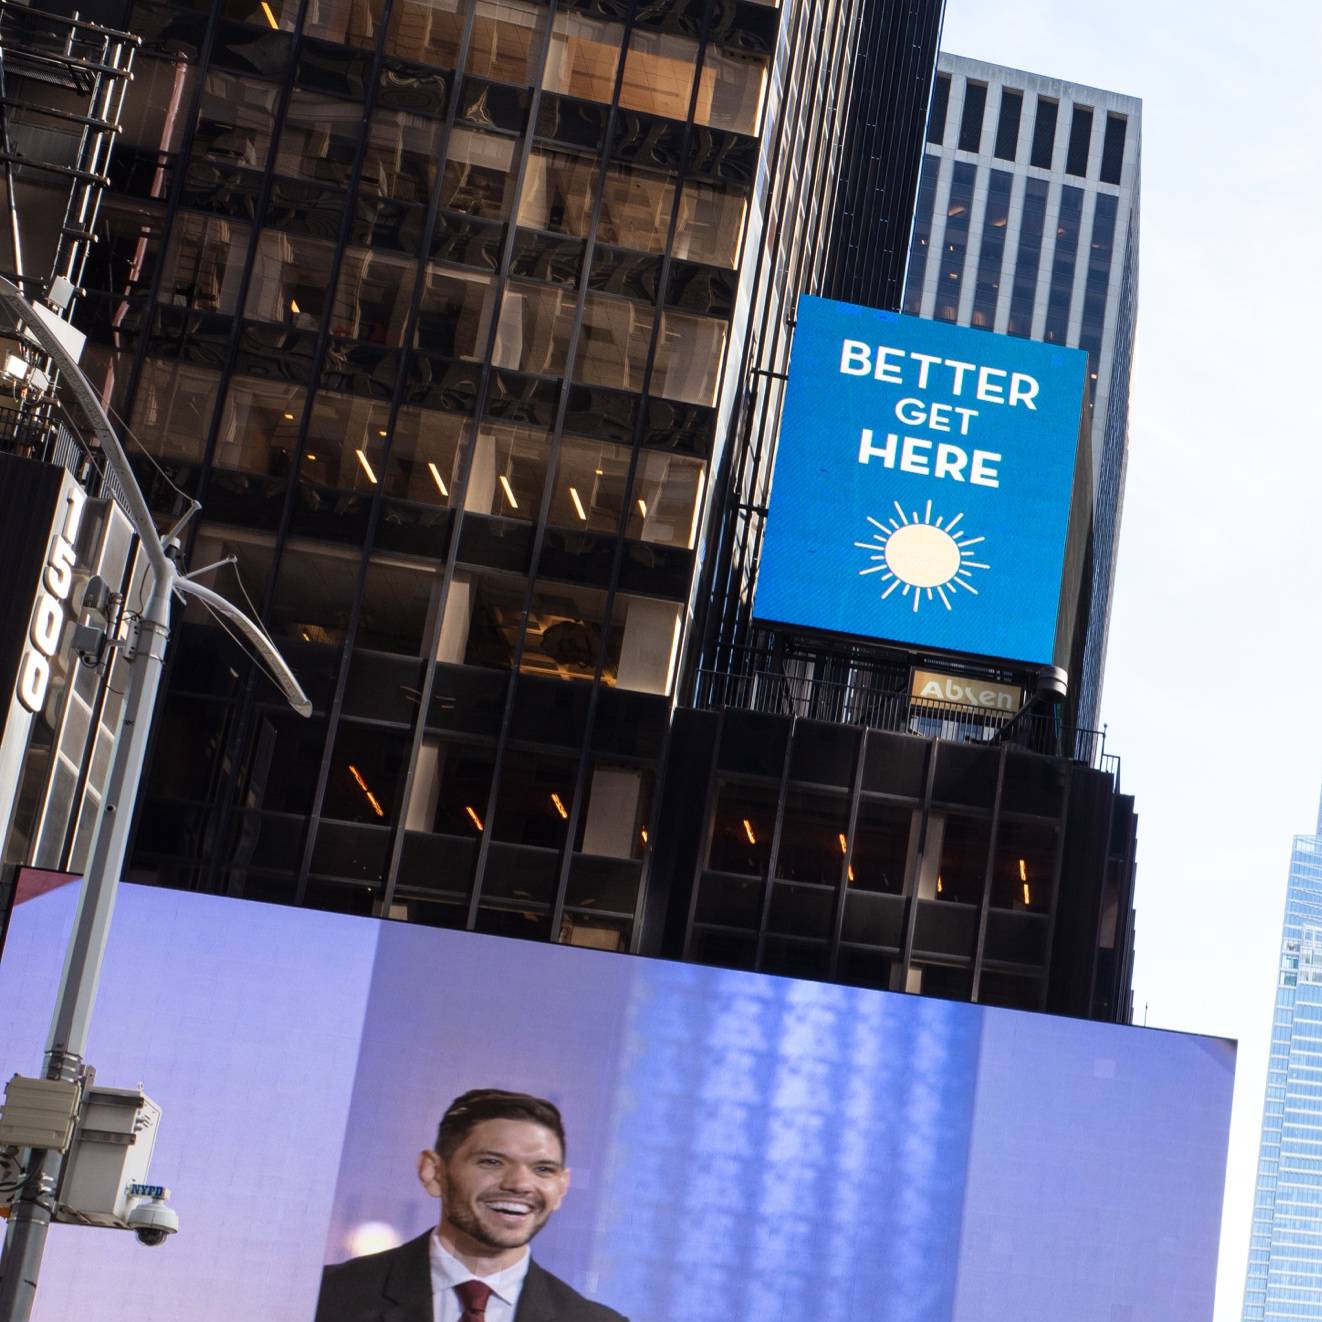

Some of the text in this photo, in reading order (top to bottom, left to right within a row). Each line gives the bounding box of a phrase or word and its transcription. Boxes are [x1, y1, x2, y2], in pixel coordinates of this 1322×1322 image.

[839, 339, 1040, 410] BETTER
[895, 398, 979, 436] GET
[858, 429, 1001, 488] HERE
[17, 487, 87, 713] 1500
[920, 679, 1013, 709] Absen
[131, 1184, 164, 1197] NYPD
